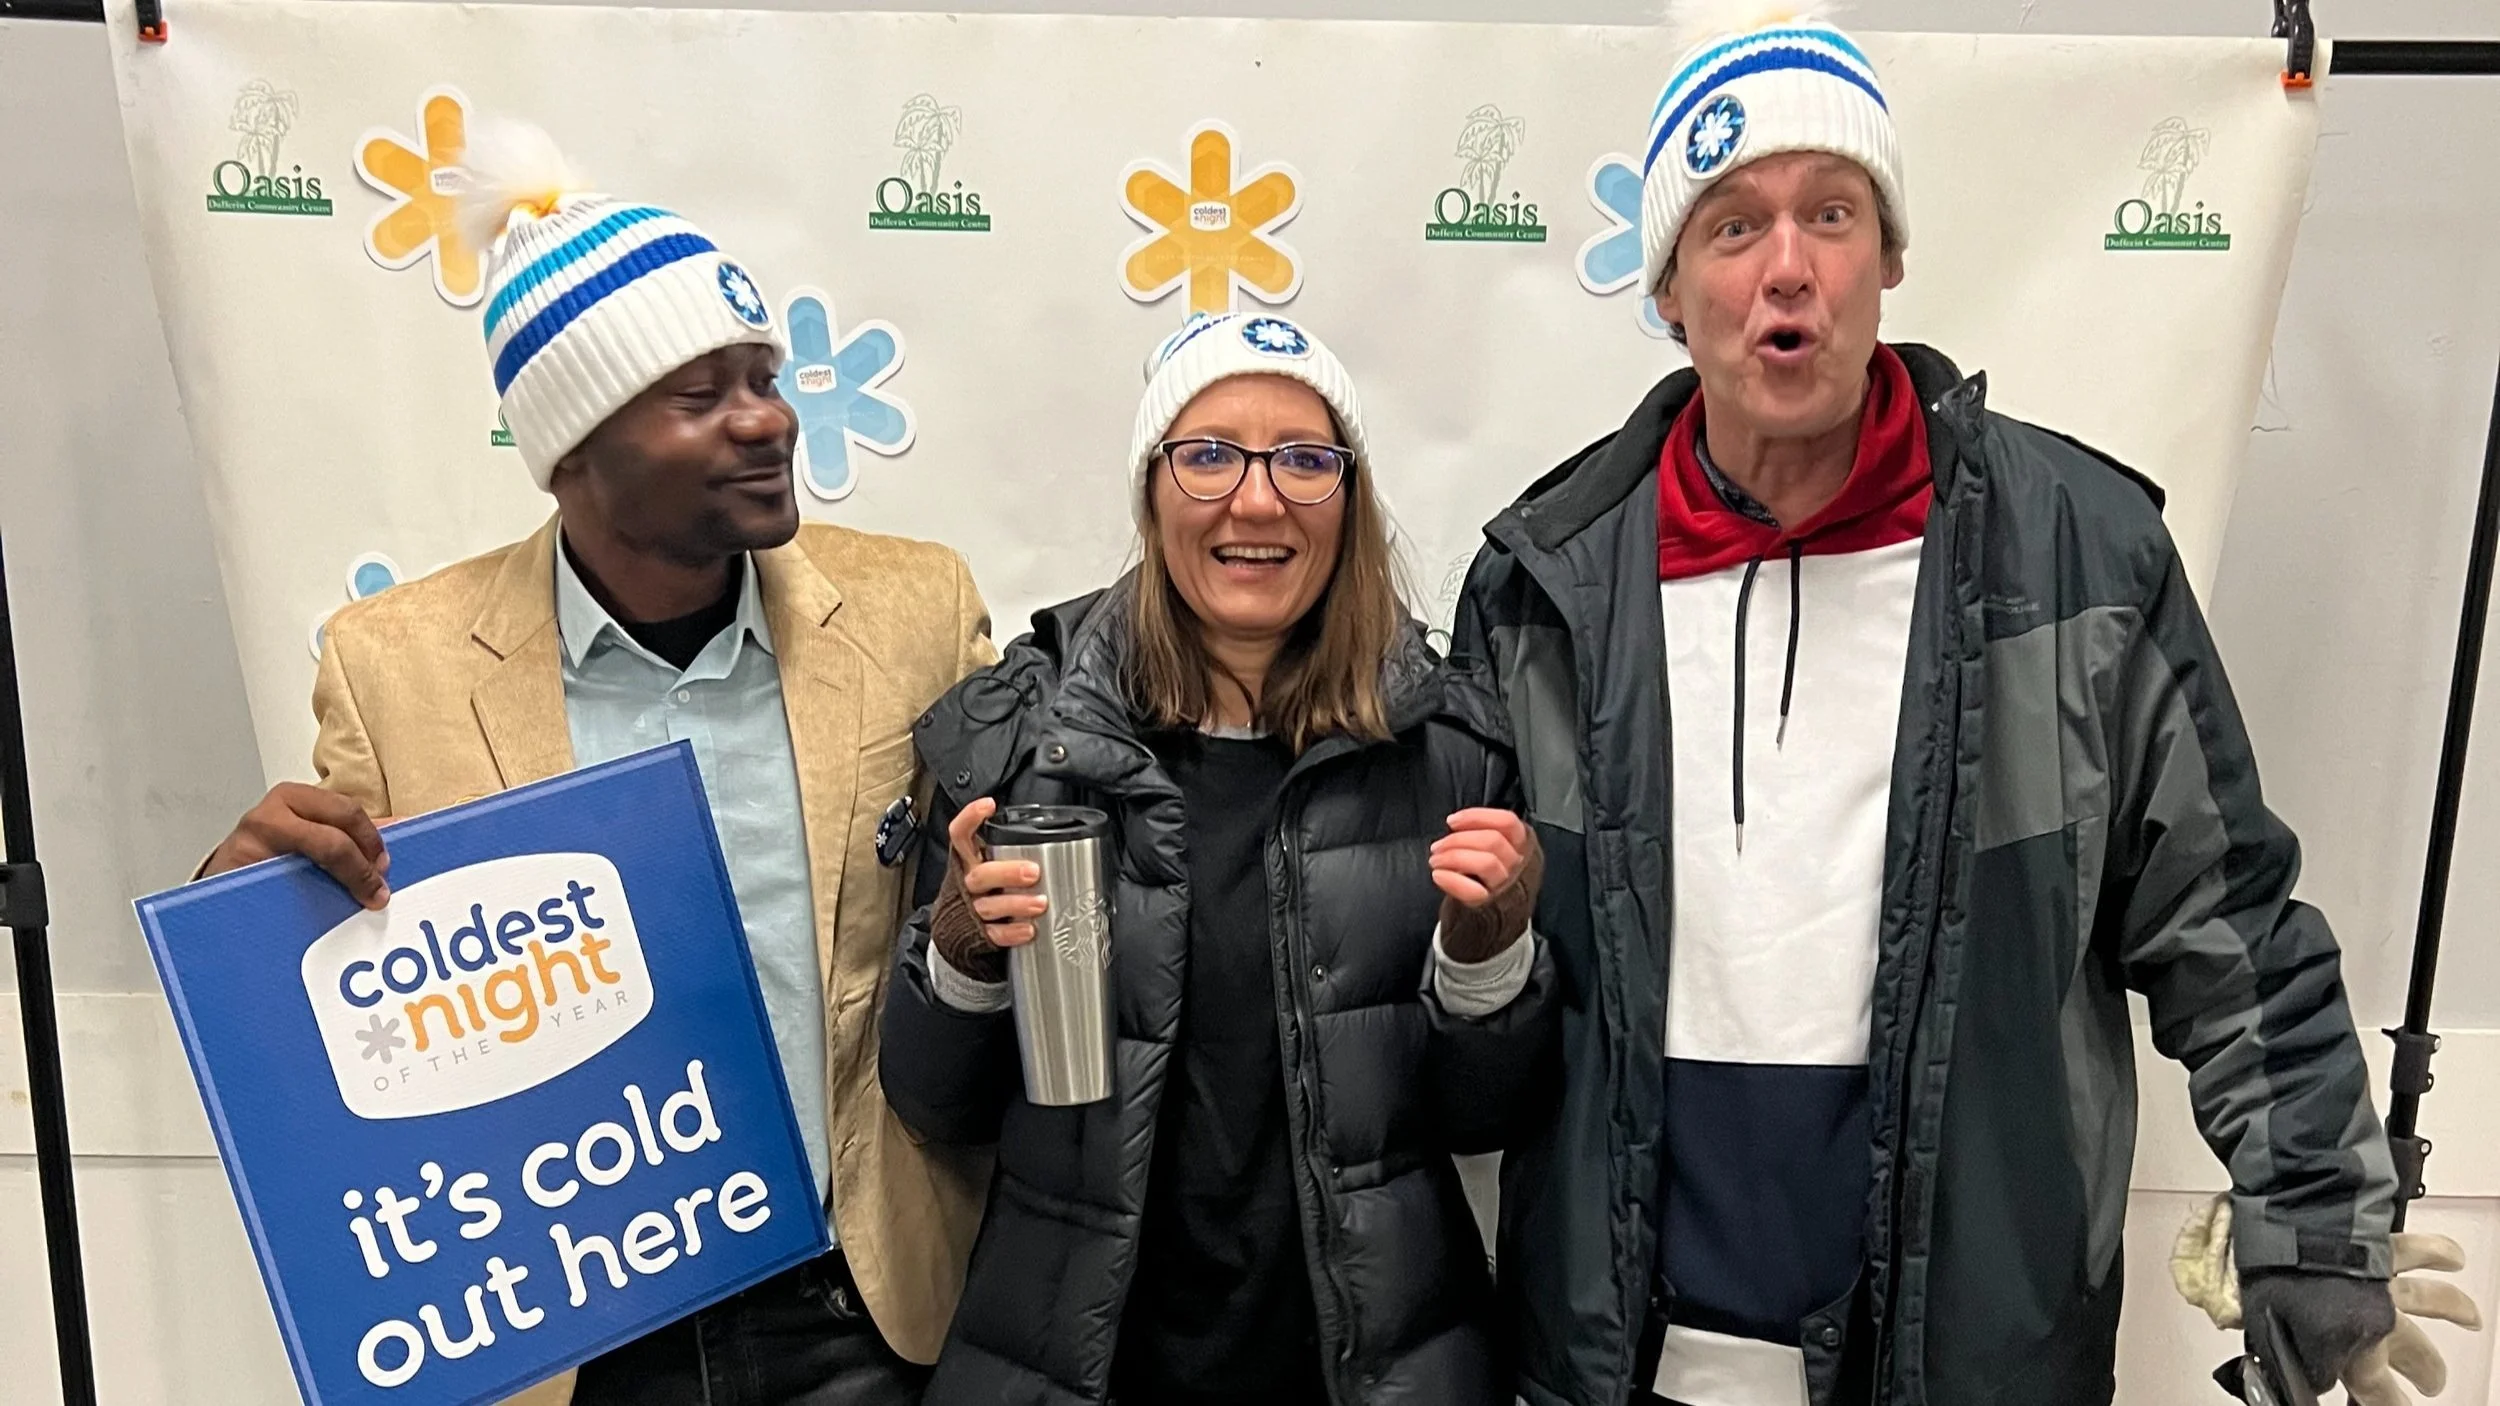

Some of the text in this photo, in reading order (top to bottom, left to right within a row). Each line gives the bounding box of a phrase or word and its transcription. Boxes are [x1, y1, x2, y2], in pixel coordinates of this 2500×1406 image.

[213, 160, 322, 200] Oasis
[876, 177, 981, 216] Oasis
[1434, 188, 1537, 226] Oasis
[2114, 199, 2221, 235] Oasis
[340, 880, 605, 1008] coldest
[404, 933, 621, 1052] night
[373, 990, 628, 1092] OF THE YEAR
[522, 1059, 722, 1208] cold
[357, 1171, 771, 1388] out here
